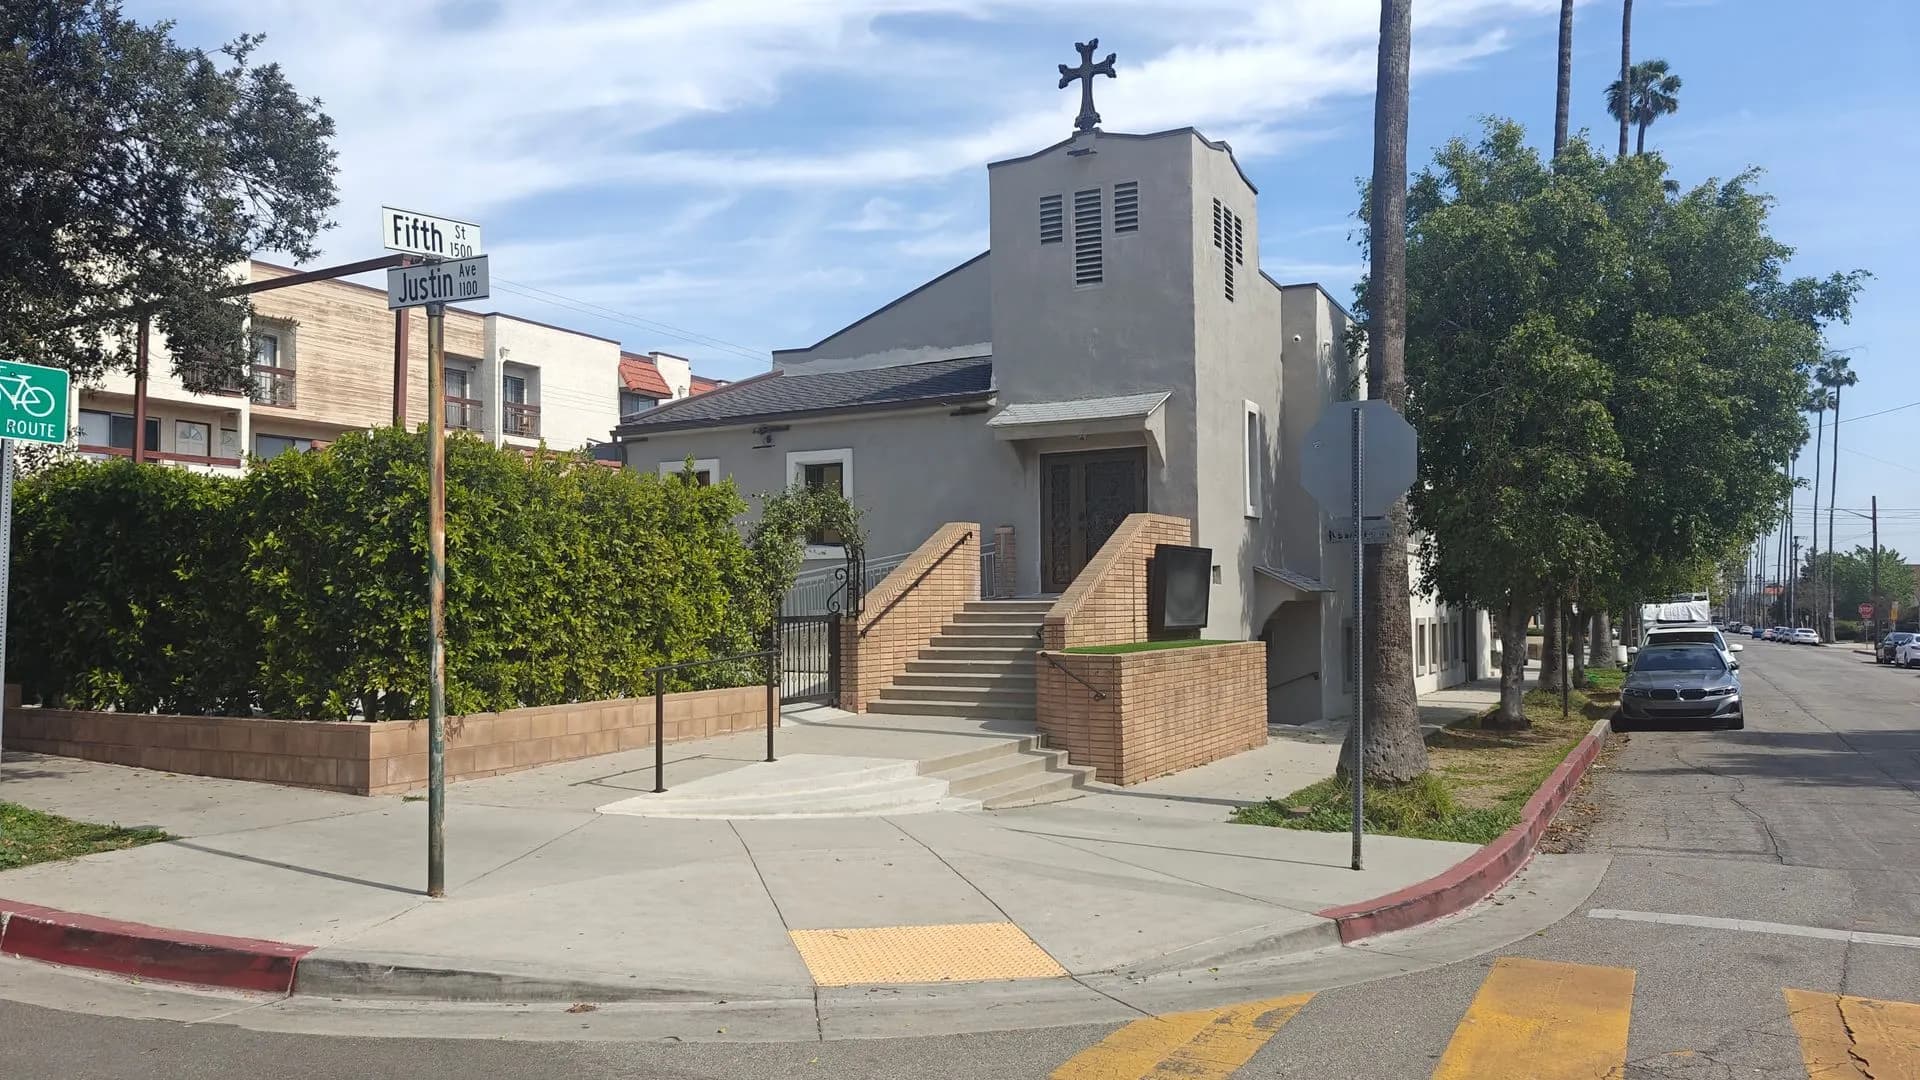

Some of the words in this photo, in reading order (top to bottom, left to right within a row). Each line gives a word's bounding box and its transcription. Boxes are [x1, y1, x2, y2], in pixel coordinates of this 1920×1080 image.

[393, 214, 443, 253] Fifth
[455, 224, 467, 240] St
[450, 242, 473, 258] 1500
[398, 267, 454, 303] Justin
[459, 263, 477, 278] Ave
[459, 280, 478, 297] 1100
[6, 418, 56, 438] ROUTE
